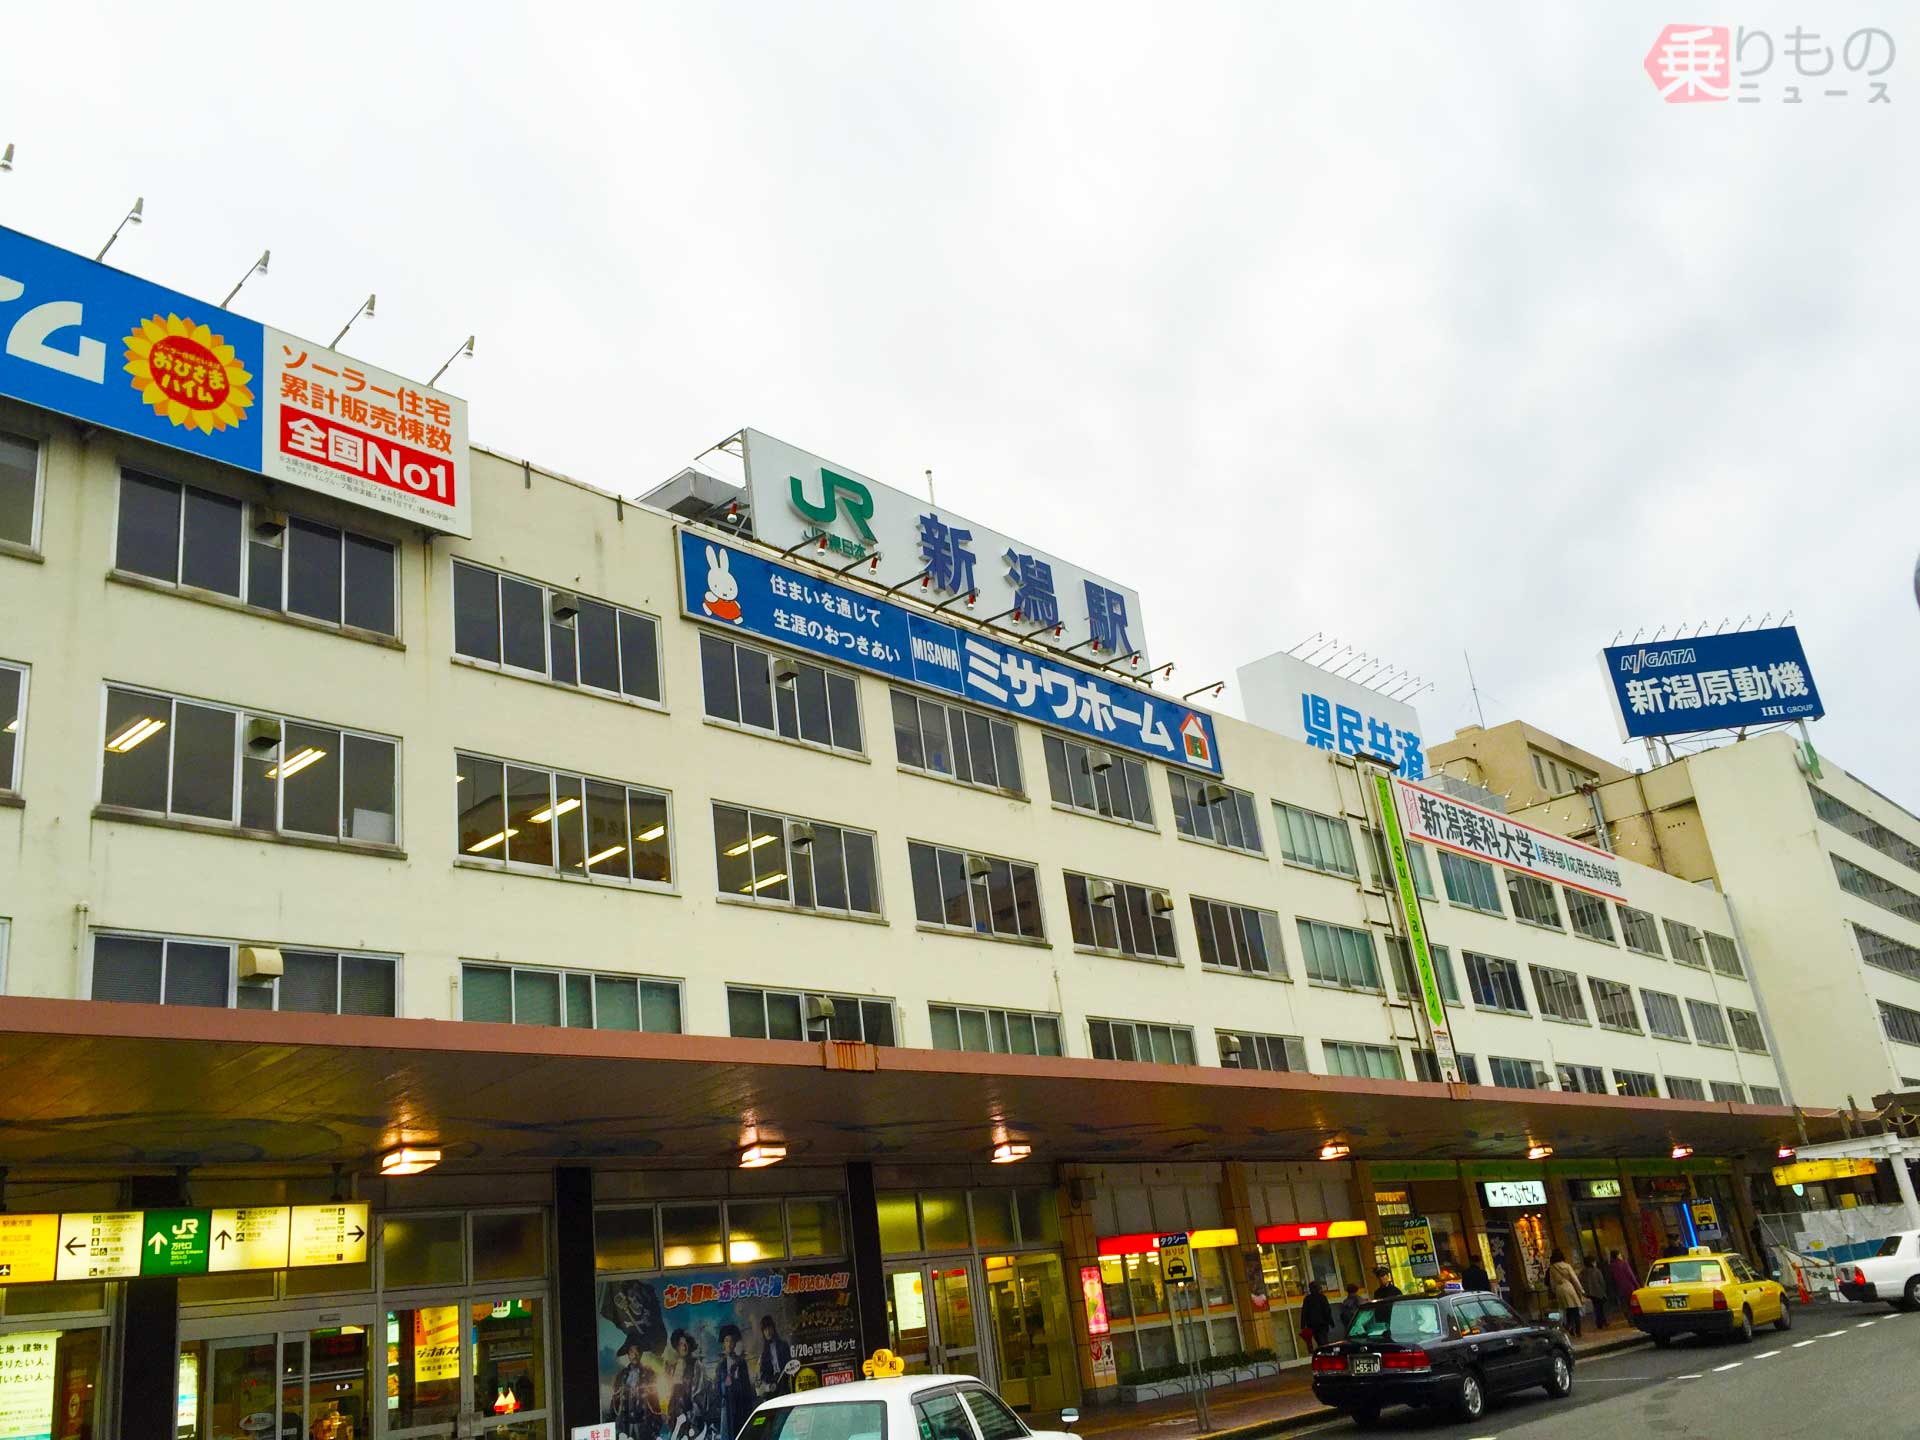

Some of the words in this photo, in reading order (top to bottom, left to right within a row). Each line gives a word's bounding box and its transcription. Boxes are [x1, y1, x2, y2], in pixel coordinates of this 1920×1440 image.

[153, 351, 225, 390] おひさま
[161, 373, 214, 403] ハイム
[282, 345, 451, 427] ソーラー住宅
[280, 372, 452, 456] 累計販売棟数
[287, 417, 447, 499] 全国No1
[790, 467, 879, 544] JR
[770, 574, 880, 628] 住まいを通じて
[917, 512, 1134, 655] 新潟駅
[773, 608, 900, 662] 生涯のおつきあい
[911, 636, 960, 672] MISAWA
[964, 637, 1175, 752] ミサワホーム
[1625, 660, 1809, 716] 新潟原動機
[1761, 705, 1786, 717] IHI
[1787, 704, 1814, 714] GROUP
[1301, 692, 1424, 781] 県民共済
[1417, 793, 1536, 867] 新潟薬科大学
[171, 1218, 199, 1235] JR
[1160, 1235, 1186, 1247] タクシー
